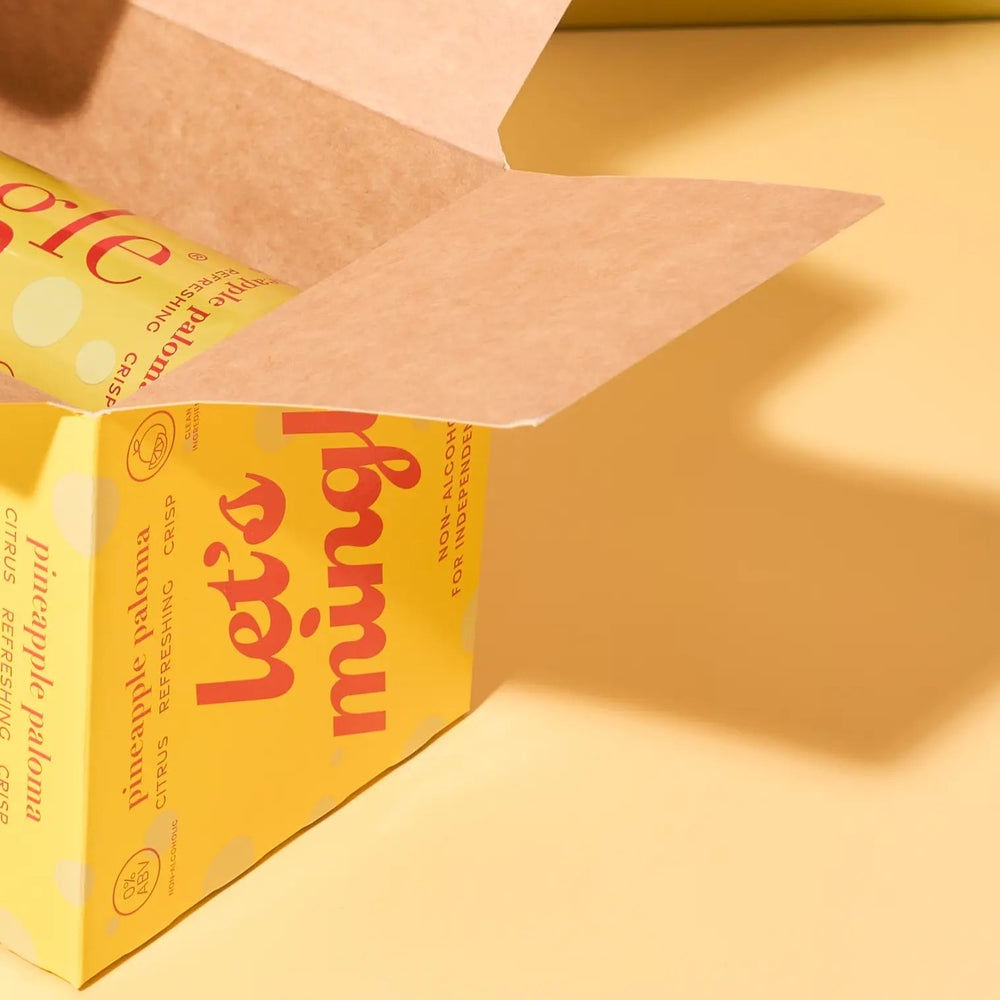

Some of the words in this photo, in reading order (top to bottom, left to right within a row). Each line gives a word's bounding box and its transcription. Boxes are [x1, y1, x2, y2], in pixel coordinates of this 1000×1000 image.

[146, 267, 241, 334] REFRESHING
[104, 351, 138, 409] CRISP
[0, 506, 18, 585] CITRUS
[162, 493, 177, 557] CRISP
[127, 523, 156, 646] paloma
[451, 553, 464, 598] FOR
[21, 534, 60, 702] pineapple
[158, 578, 176, 715] REFRESHING
[20, 706, 52, 824] paloma
[122, 653, 153, 813] pineapple
[154, 734, 170, 811] CITRUS
[123, 871, 137, 900] 0%
[136, 860, 150, 895] ABV
